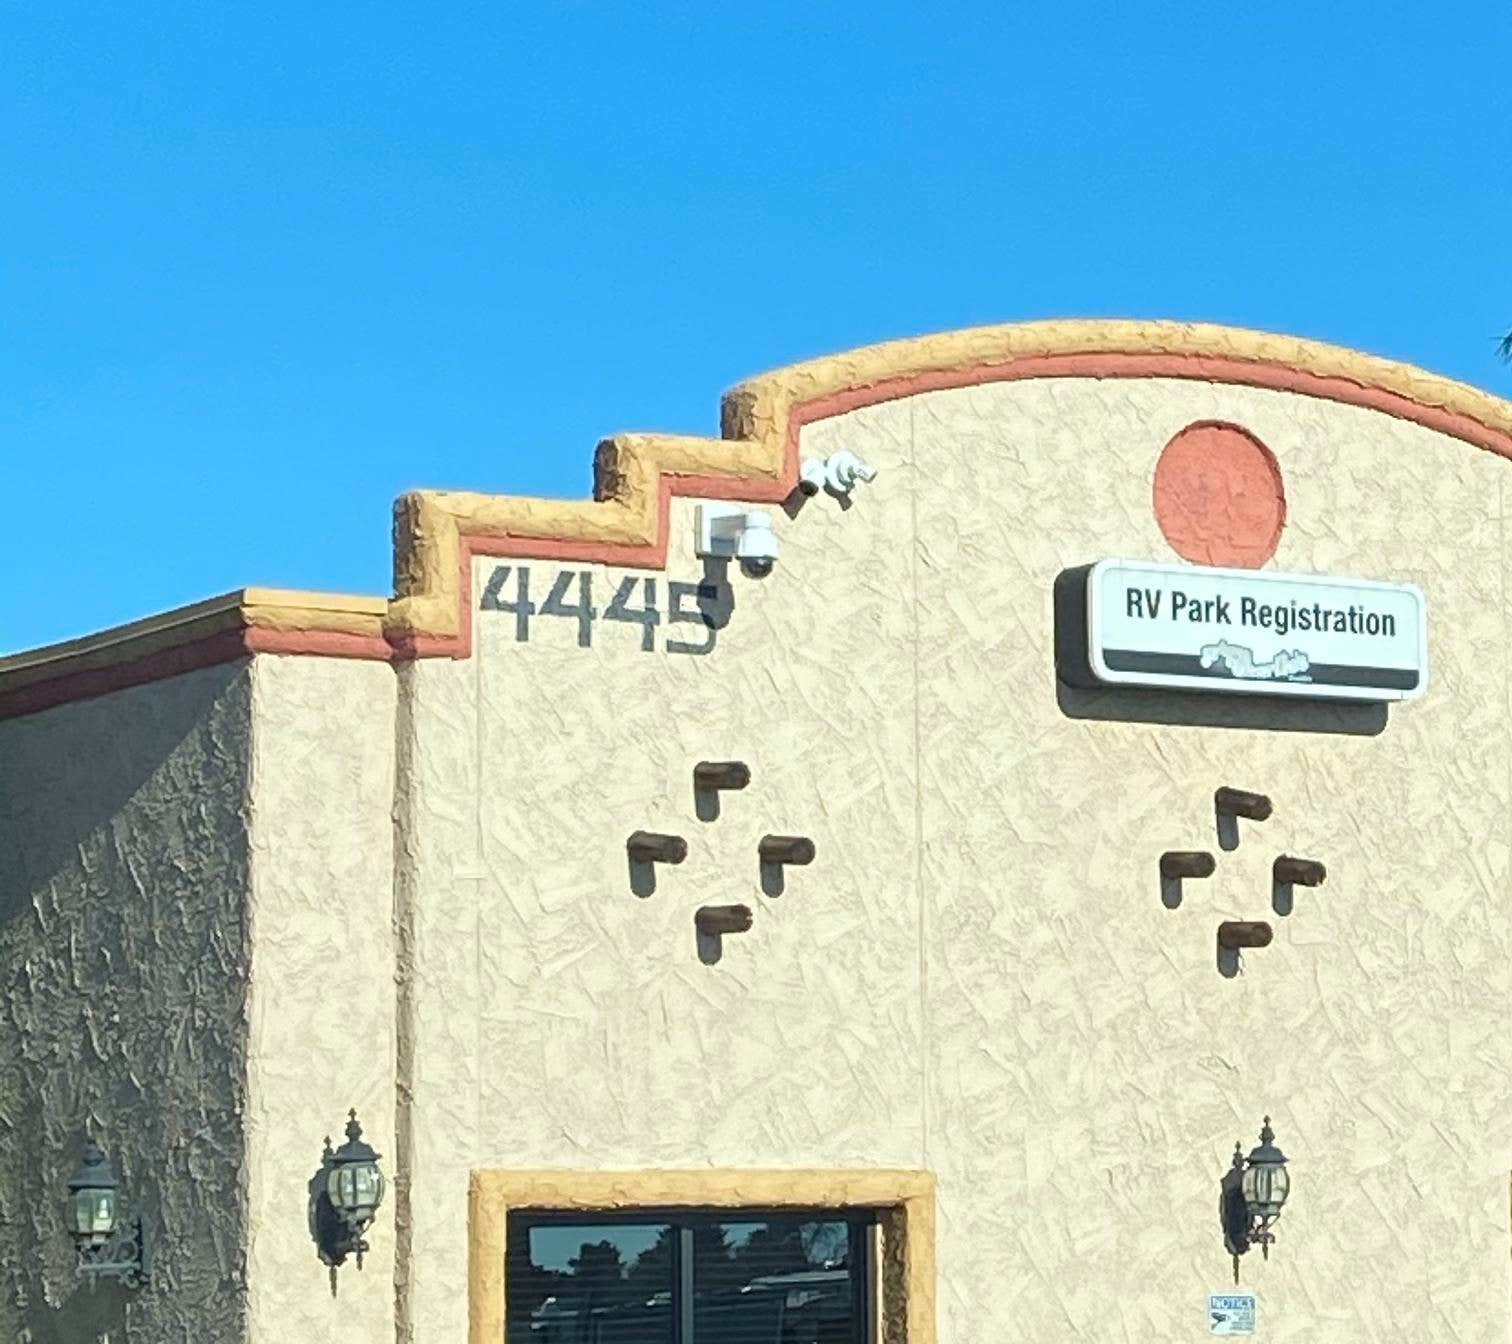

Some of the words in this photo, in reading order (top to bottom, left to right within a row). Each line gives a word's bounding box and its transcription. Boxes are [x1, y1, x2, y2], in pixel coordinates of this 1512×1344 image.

[480, 565, 717, 655] 4445
[1126, 587, 1162, 619] RV
[1171, 590, 1232, 625] Park
[1240, 596, 1397, 637] Registration
